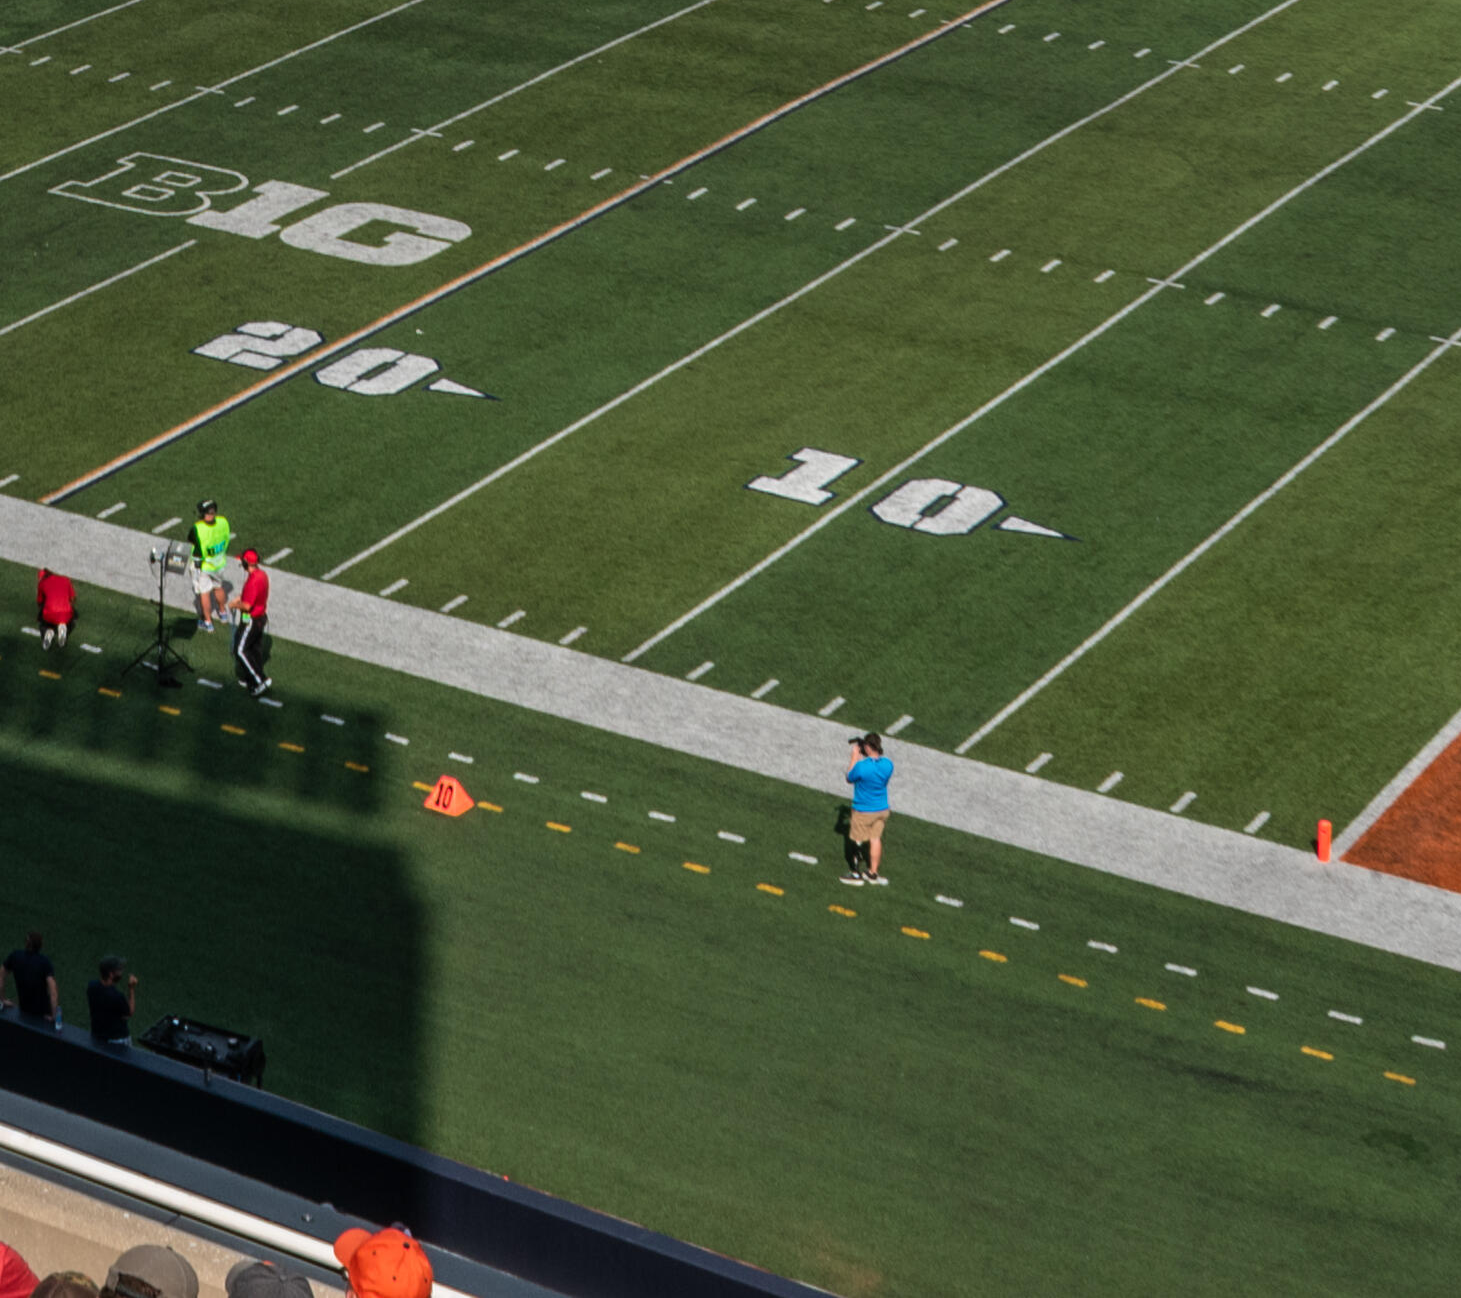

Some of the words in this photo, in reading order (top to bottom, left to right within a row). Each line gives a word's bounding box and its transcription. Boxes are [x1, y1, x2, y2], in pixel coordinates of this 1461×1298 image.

[193, 319, 442, 397] 20
[745, 447, 1008, 538] 10
[435, 783, 454, 808] 10
